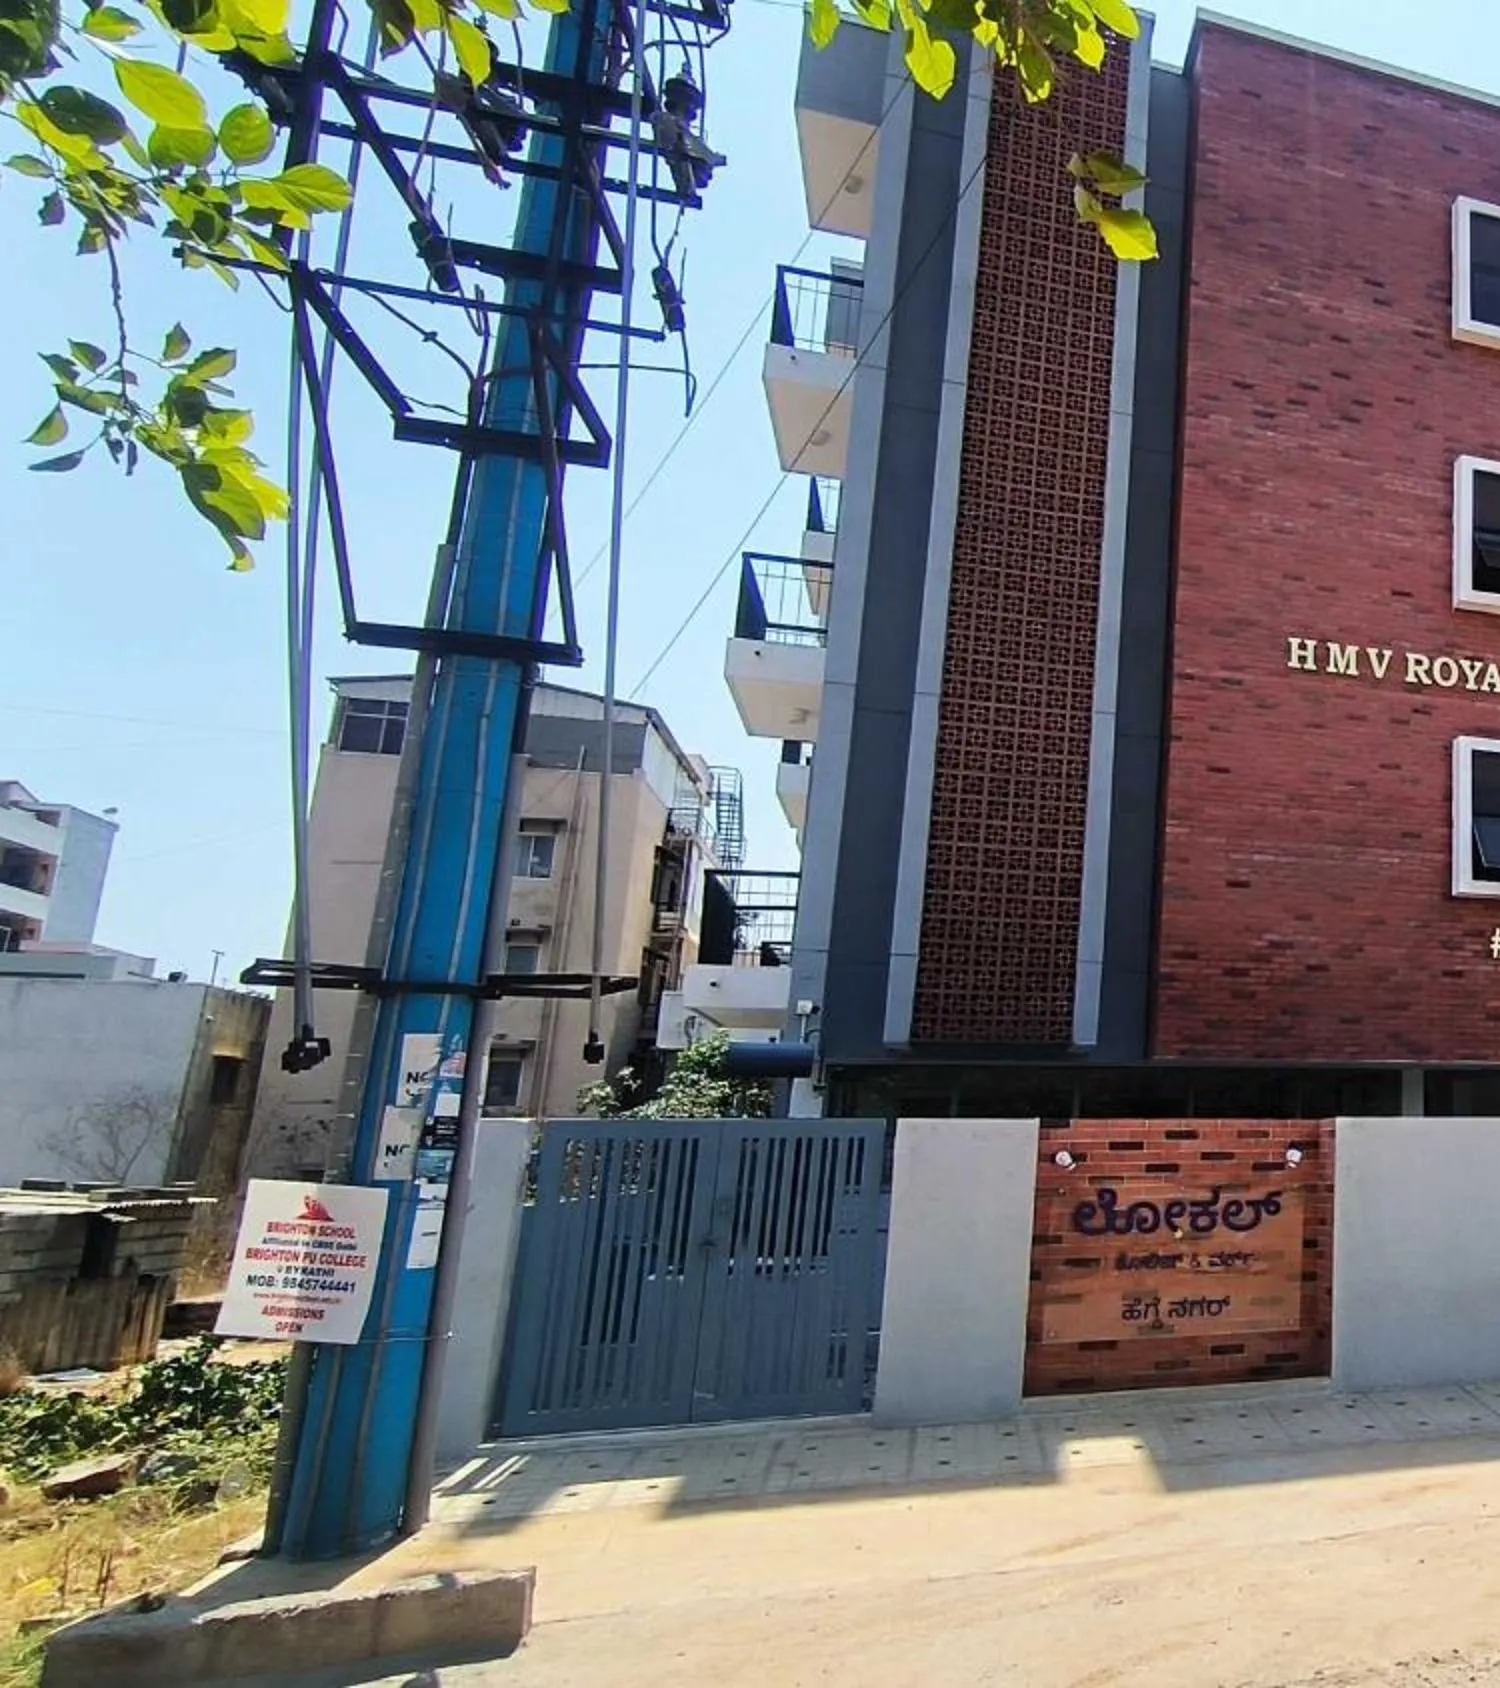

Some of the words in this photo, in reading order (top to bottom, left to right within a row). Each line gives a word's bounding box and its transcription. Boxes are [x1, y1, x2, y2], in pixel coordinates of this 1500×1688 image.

[1071, 1184, 1284, 1236] ಲೋಕಲ್
[266, 1221, 316, 1237] BRIGHTON
[318, 1226, 357, 1239] SCHOOL
[245, 1247, 301, 1263] BRIGHTON
[302, 1251, 318, 1264] PU
[319, 1253, 368, 1268] COLLEGE
[246, 1274, 279, 1288] MOB:
[261, 1304, 325, 1320] ADMISSIONS
[275, 1321, 305, 1333] OPEN
